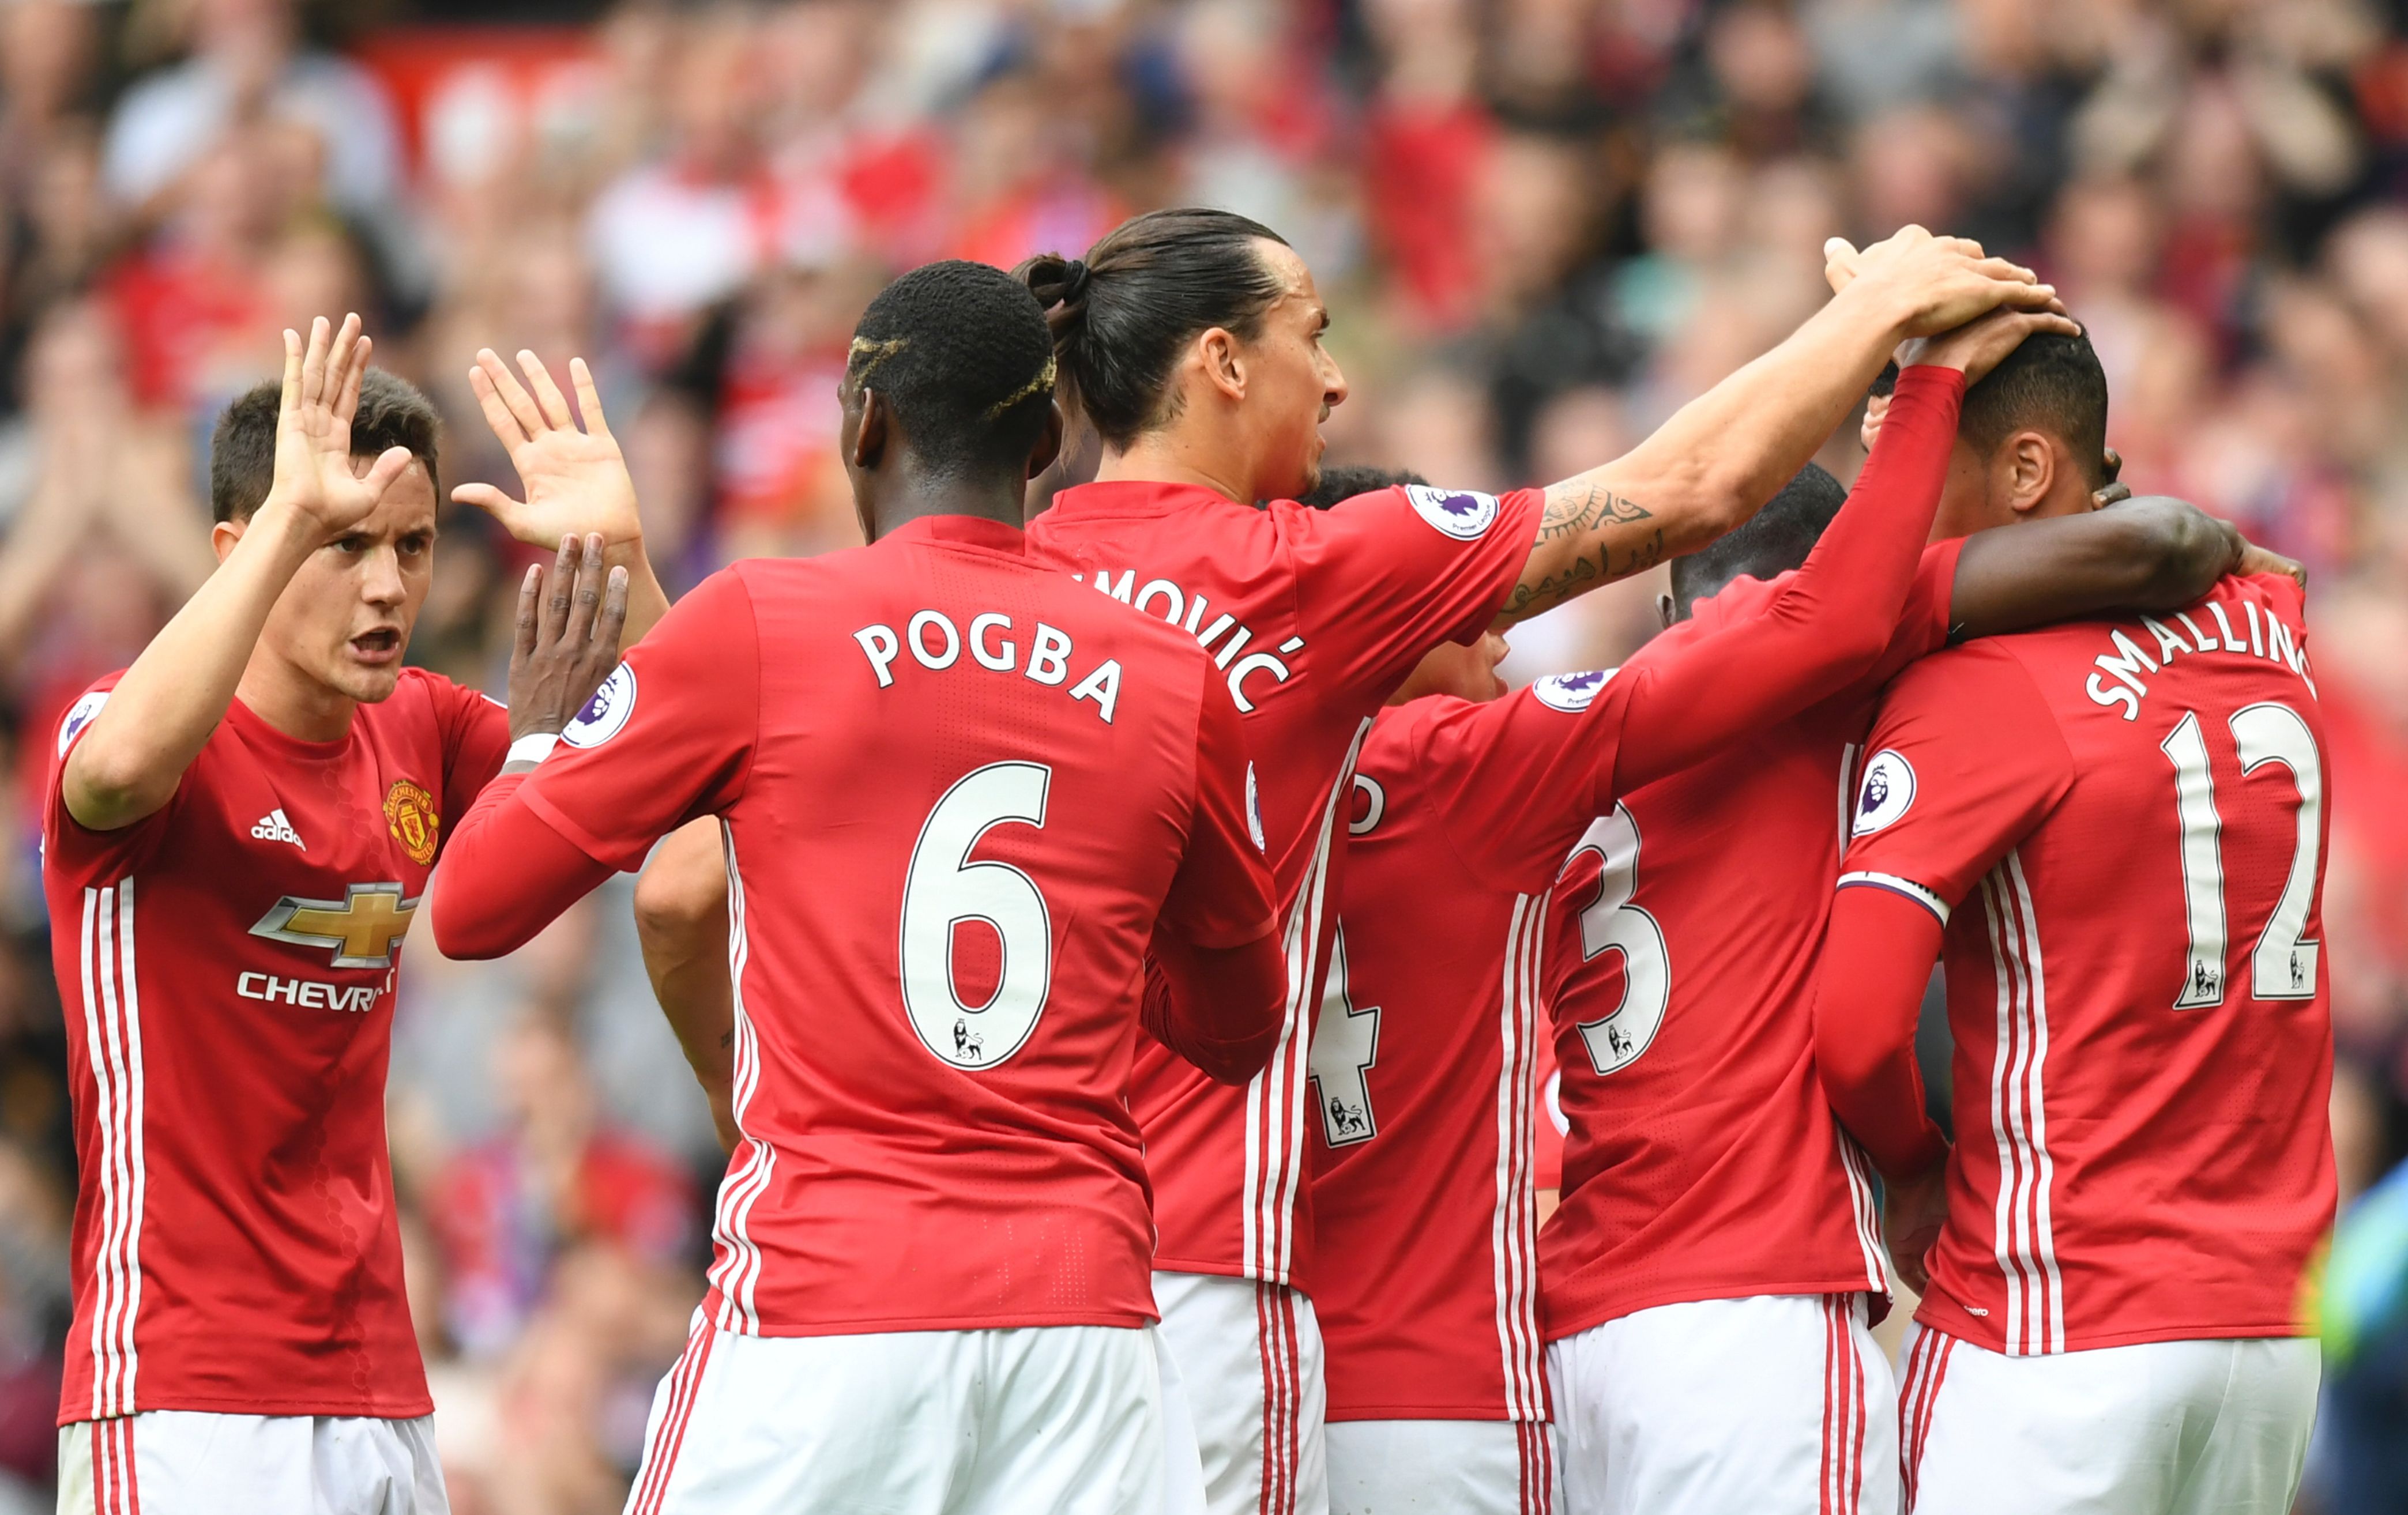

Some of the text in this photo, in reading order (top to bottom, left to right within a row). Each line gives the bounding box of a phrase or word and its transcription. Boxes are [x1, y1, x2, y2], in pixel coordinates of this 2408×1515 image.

[852, 609, 1123, 725] POGBA
[1071, 568, 1306, 714] MOVIĆ
[383, 786, 428, 817] MANCHESTER
[408, 842, 433, 860] UNITED
[2160, 702, 2322, 1010] 12
[899, 760, 1052, 1071] 6
[1556, 798, 1671, 1076] 3
[236, 967, 396, 1012] CHEVR
